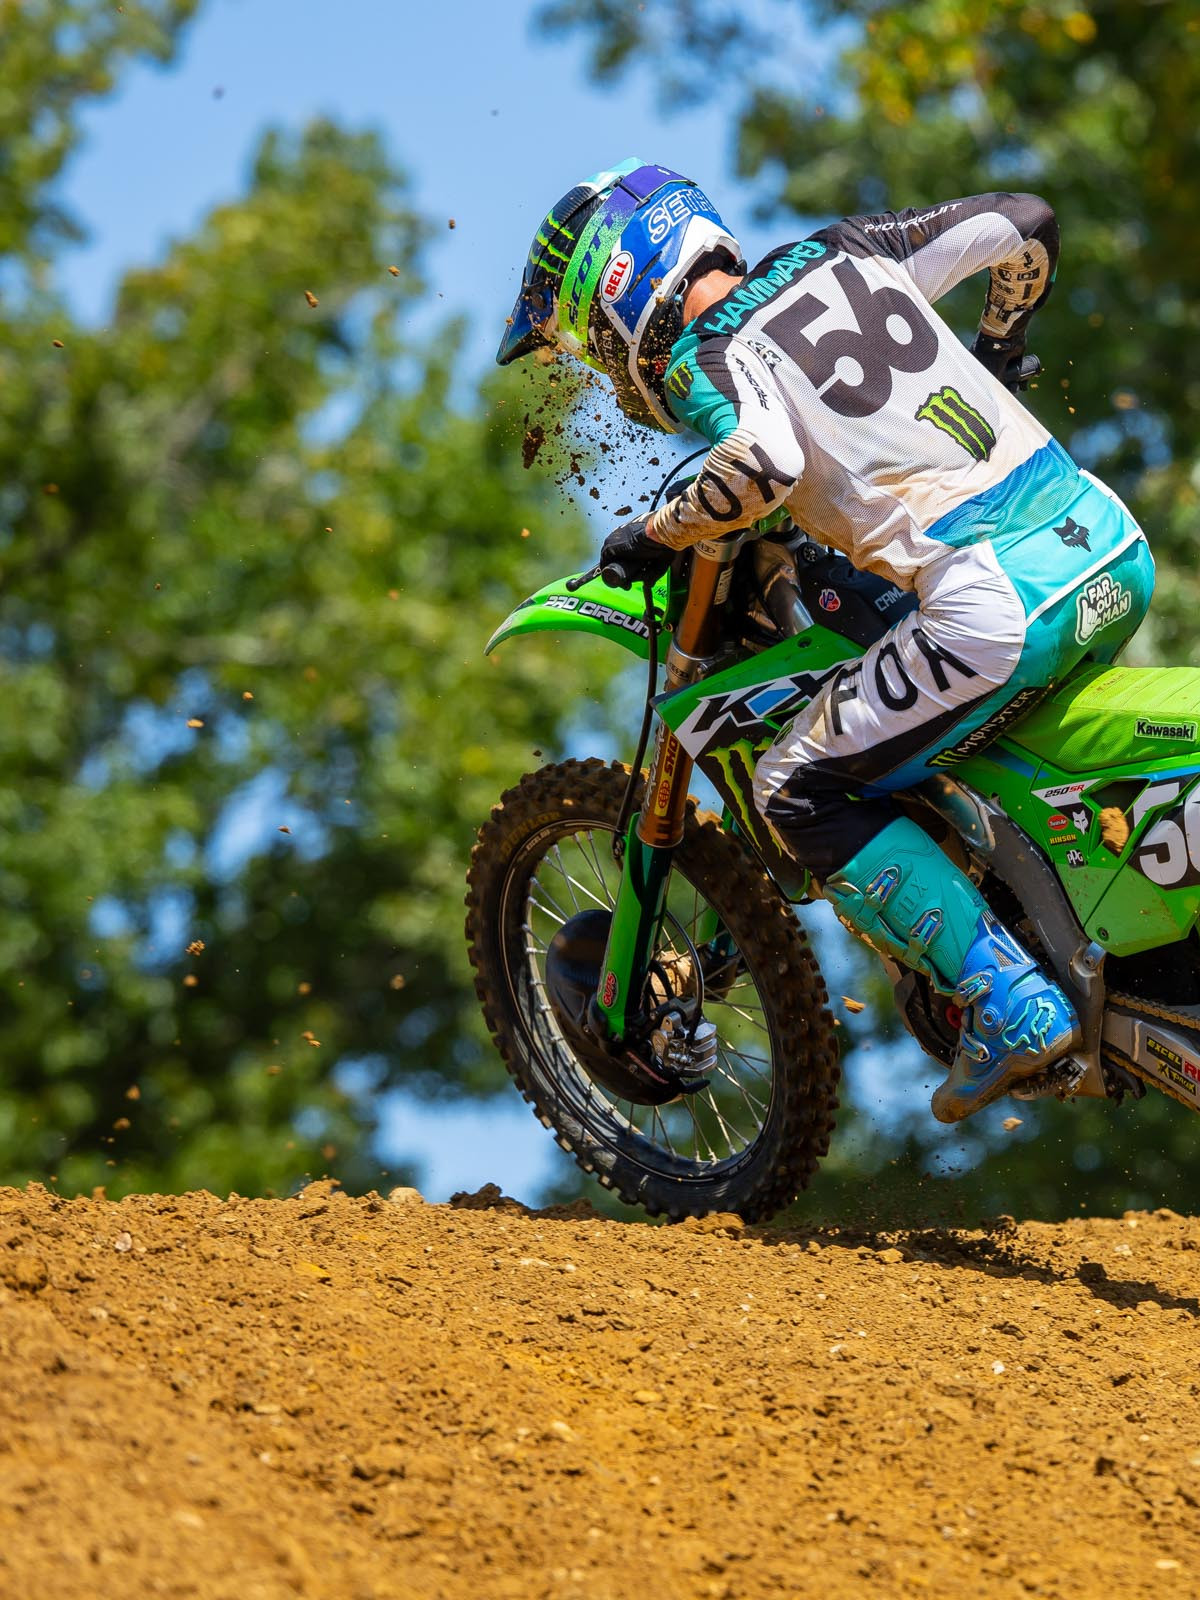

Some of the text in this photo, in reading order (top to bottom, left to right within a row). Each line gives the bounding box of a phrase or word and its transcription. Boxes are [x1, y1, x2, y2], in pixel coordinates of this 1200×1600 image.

[604, 260, 630, 297] BELL
[762, 256, 939, 418] 56
[1088, 579, 1110, 604] FAR
[1096, 588, 1119, 614] OUT
[543, 595, 652, 638] PRO CIRCUI
[1102, 596, 1128, 625] MAN
[830, 627, 977, 736] FOX
[1136, 720, 1194, 740] Kawasaki
[1044, 784, 1085, 798] 250SR
[1049, 833, 1077, 845] HINSON
[1066, 849, 1084, 865] PPG
[1147, 1039, 1181, 1065] EXCEL
